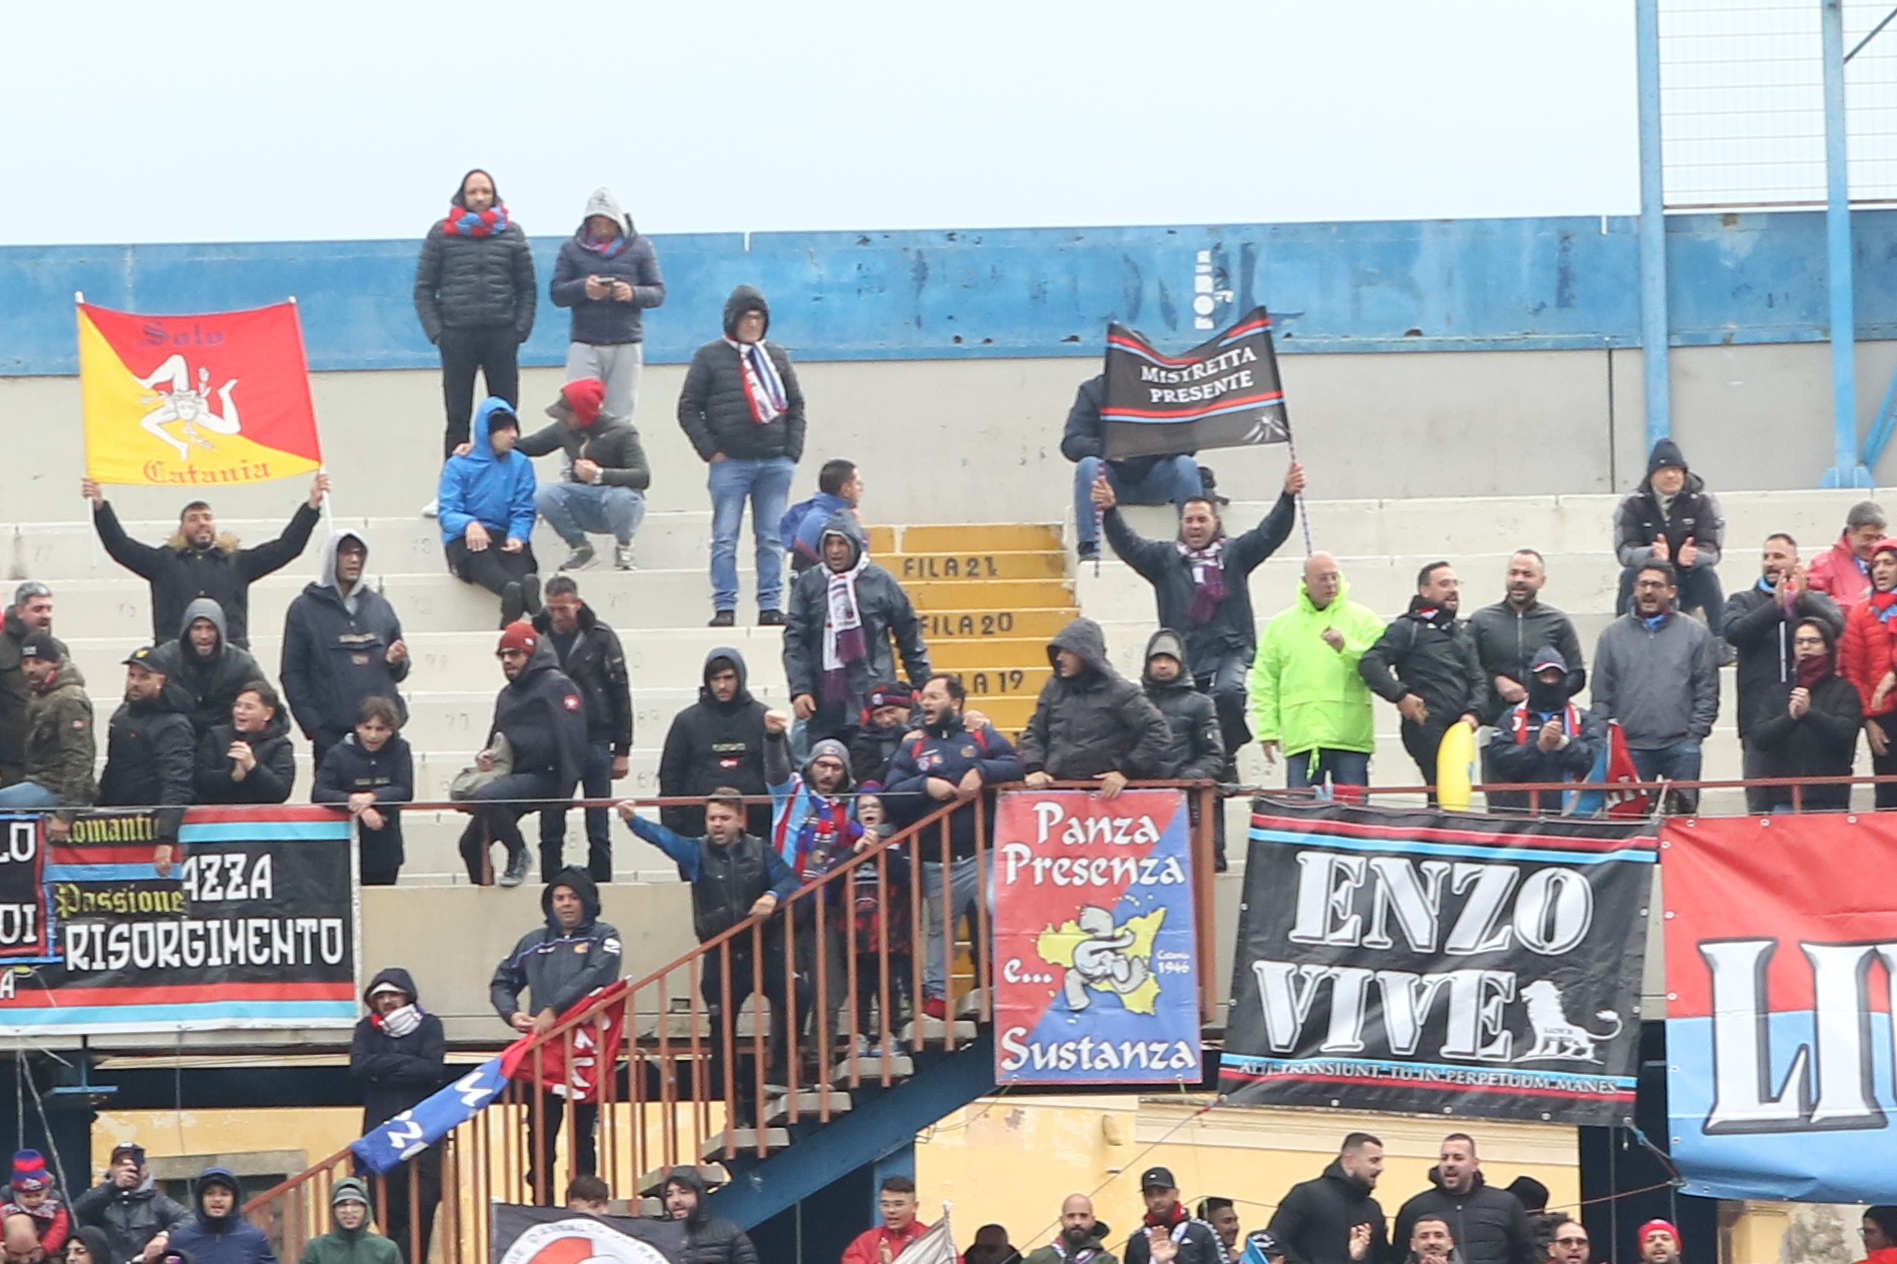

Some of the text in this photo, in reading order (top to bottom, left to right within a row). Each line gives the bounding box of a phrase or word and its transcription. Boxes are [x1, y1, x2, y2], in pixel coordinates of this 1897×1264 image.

[1141, 347, 1256, 384] MISTRETTA
[1150, 370, 1253, 403] PRESENTE
[143, 459, 272, 485] Catania
[904, 557, 958, 577] FILA
[919, 612, 1014, 635] FILA 20
[999, 670, 1024, 692] 19
[1033, 801, 1160, 845] Panza
[1002, 843, 1185, 886] Presenza
[56, 883, 183, 918] Passione
[1289, 851, 1593, 956] ENZO
[65, 917, 343, 972] RISORGIMENTO
[1252, 960, 1516, 1062] VIVE
[1000, 1027, 1198, 1072] Sustanza
[1697, 936, 1897, 1136] LI
